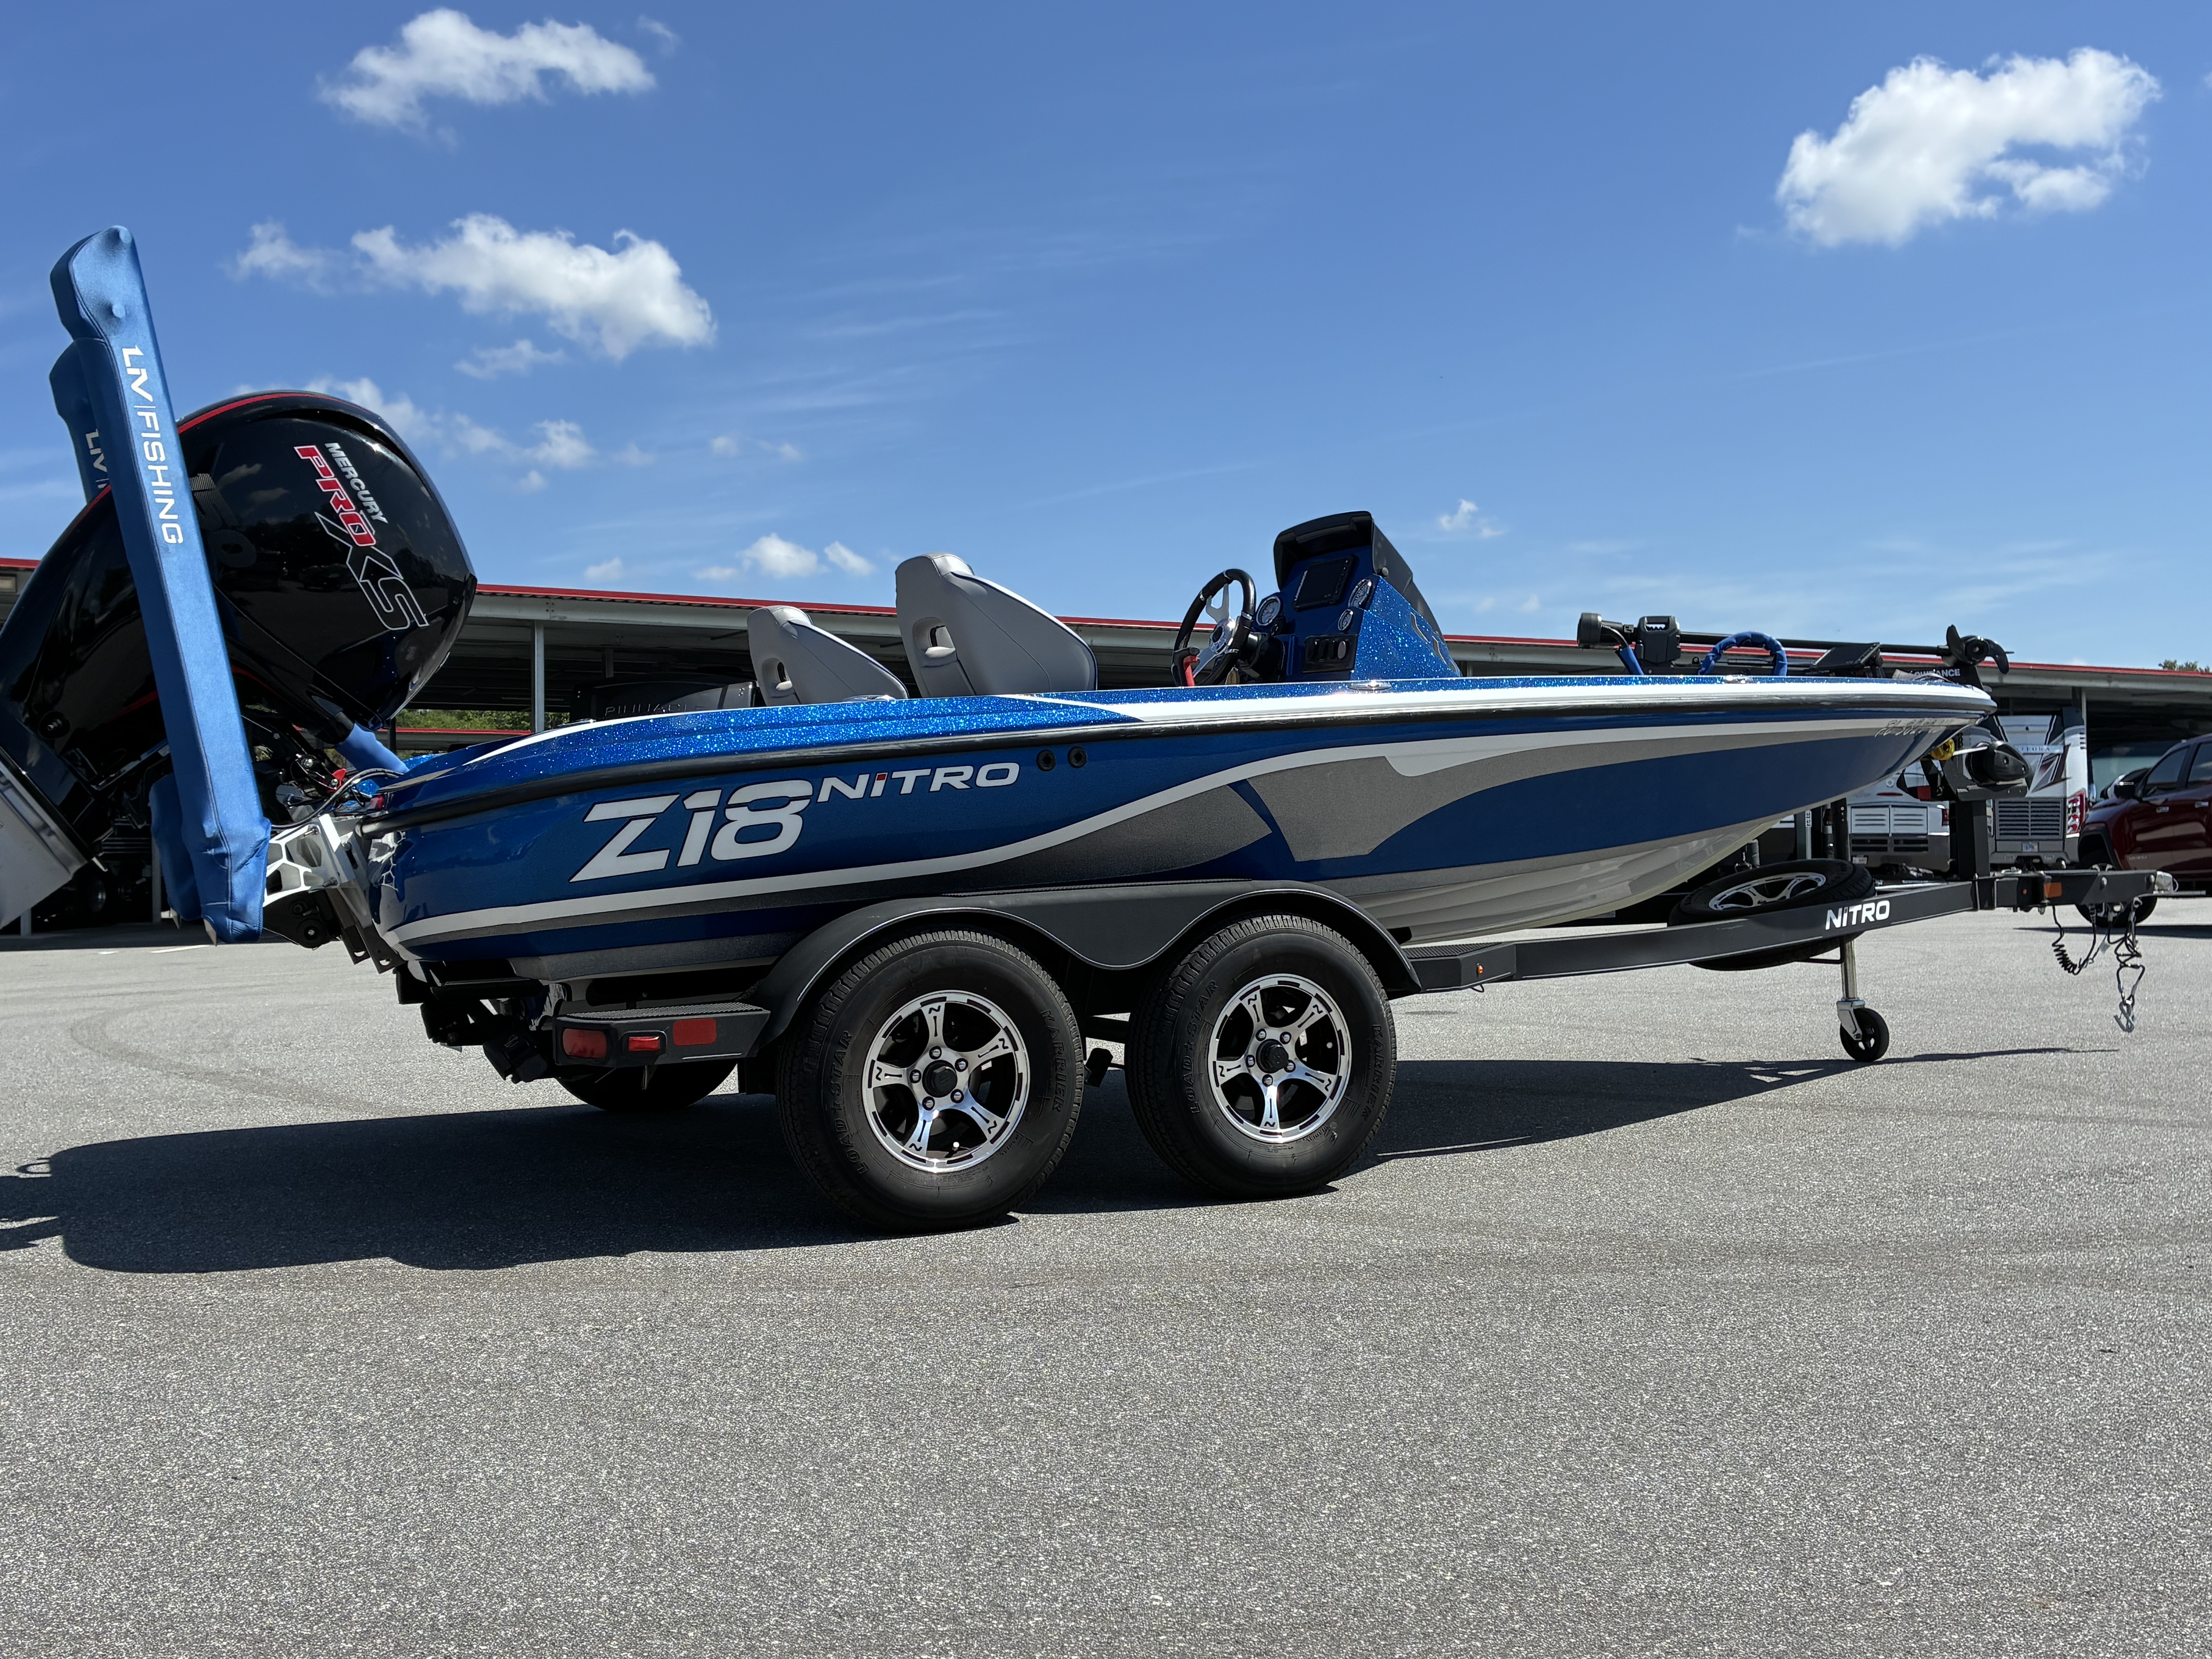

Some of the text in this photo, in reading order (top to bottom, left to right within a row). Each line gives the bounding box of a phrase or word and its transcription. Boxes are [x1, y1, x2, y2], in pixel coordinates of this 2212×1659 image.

[122, 345, 183, 544] LIV FISHING
[325, 442, 388, 524] MERCURY
[294, 445, 429, 630] PRO XS
[568, 779, 814, 883] Z18
[830, 1030, 870, 1175] LOAD STAR
[1041, 1010, 1067, 1113] KARRIER
[1183, 980, 1218, 1113] LOAD STAR
[1361, 1024, 1384, 1121] KARRIER
